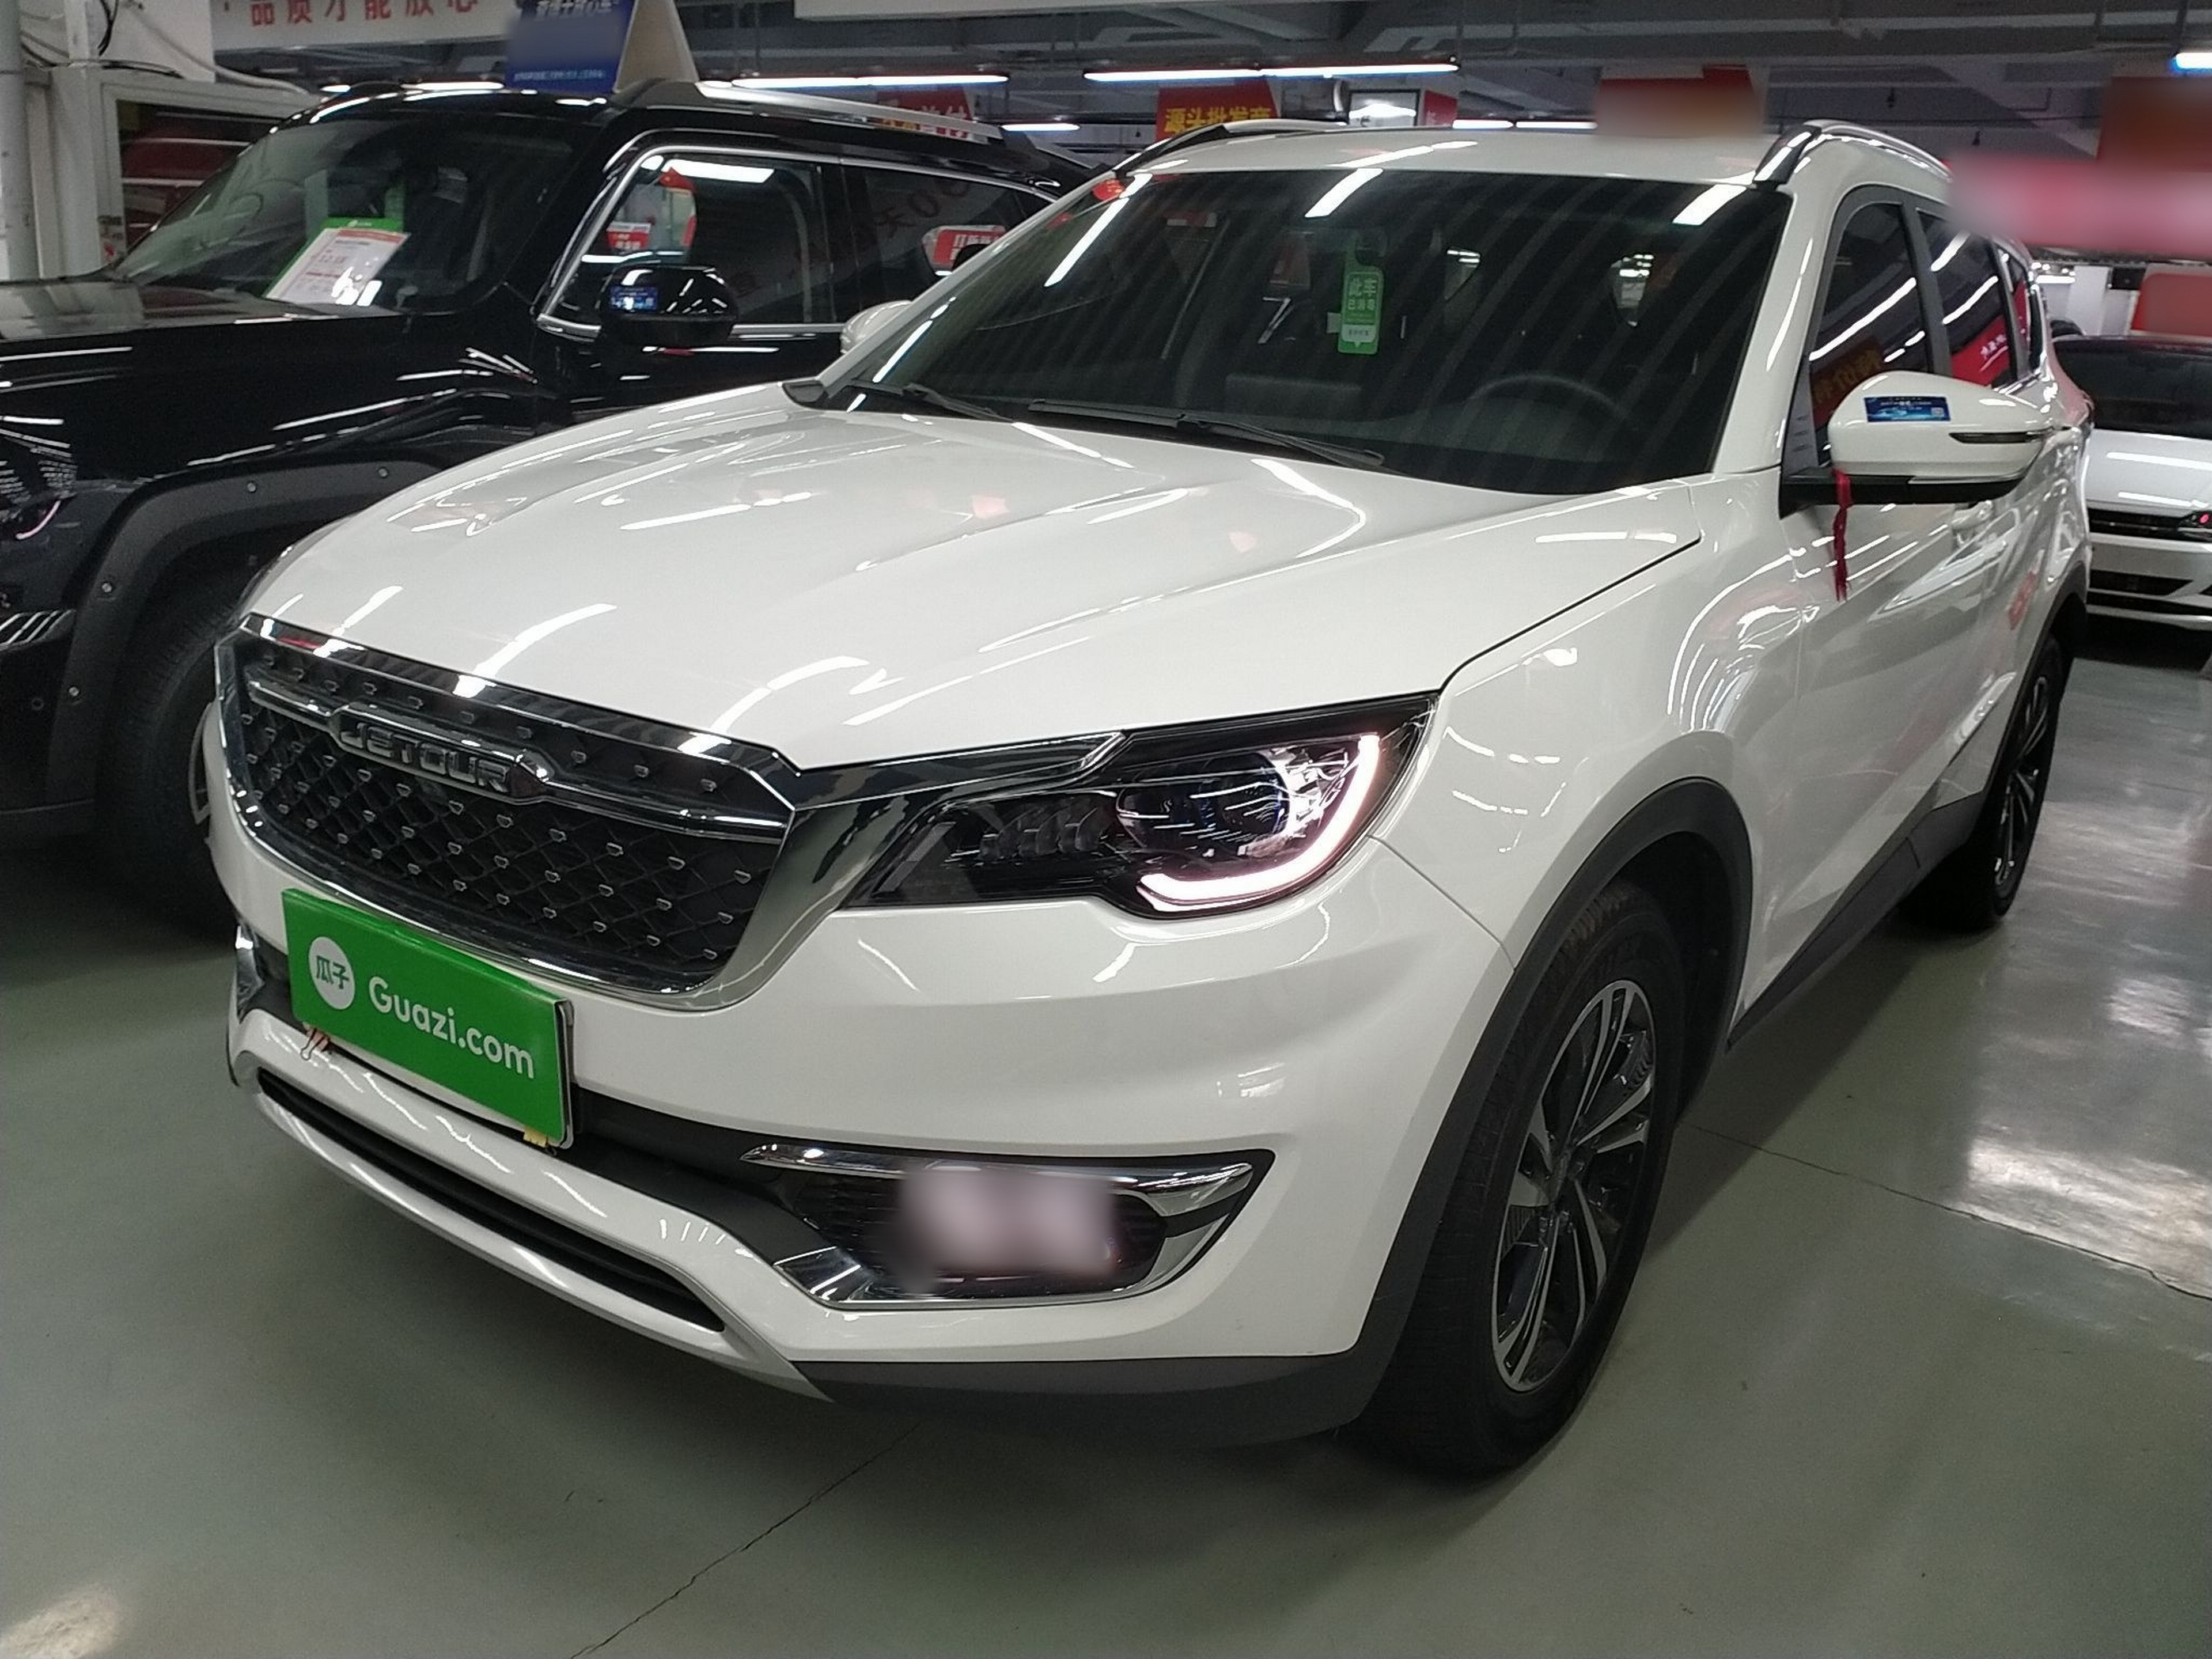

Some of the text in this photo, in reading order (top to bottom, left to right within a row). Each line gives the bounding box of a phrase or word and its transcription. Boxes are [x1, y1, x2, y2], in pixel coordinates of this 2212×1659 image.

[340, 722, 509, 792] JETOUR
[316, 955, 350, 989] 瓜子
[369, 976, 534, 1079] Guazi.com
